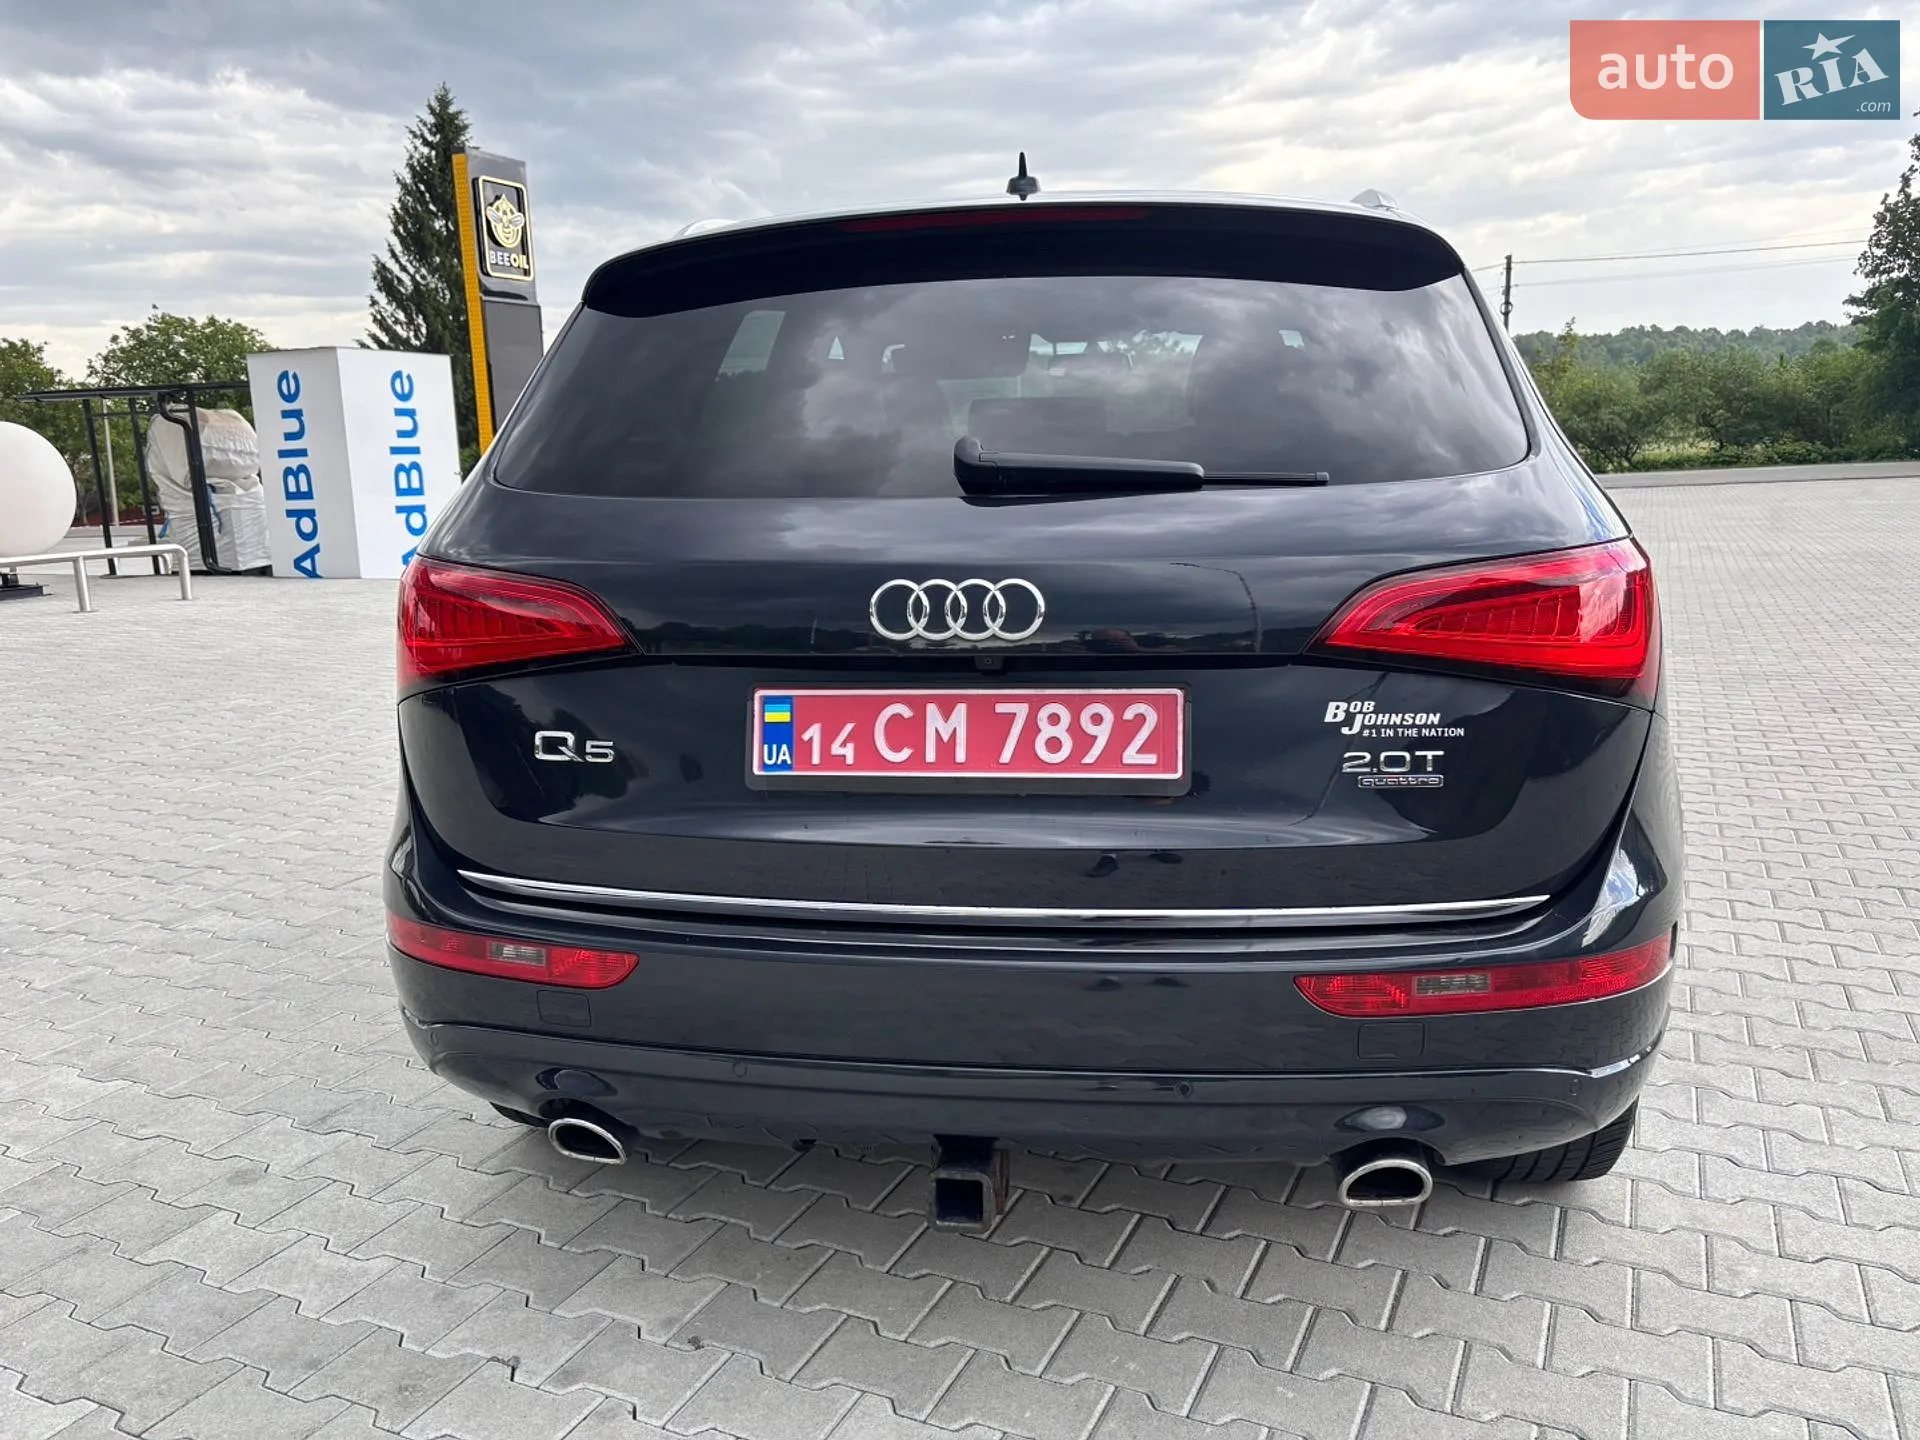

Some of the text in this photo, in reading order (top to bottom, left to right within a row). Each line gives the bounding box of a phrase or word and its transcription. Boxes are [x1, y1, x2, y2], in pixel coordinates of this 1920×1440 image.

[276, 369, 323, 579] AdBlue
[1324, 701, 1376, 723] BOB
[800, 702, 1159, 766] 14 CM 7892
[1341, 713, 1441, 735] JOHNSON
[1381, 728, 1394, 738] IN
[1398, 728, 1418, 738] THE
[1421, 727, 1465, 738] NATION
[534, 730, 615, 763] Q5
[763, 743, 791, 765] UA
[1342, 751, 1444, 773] 2.0T
[1362, 777, 1440, 787] quattro
